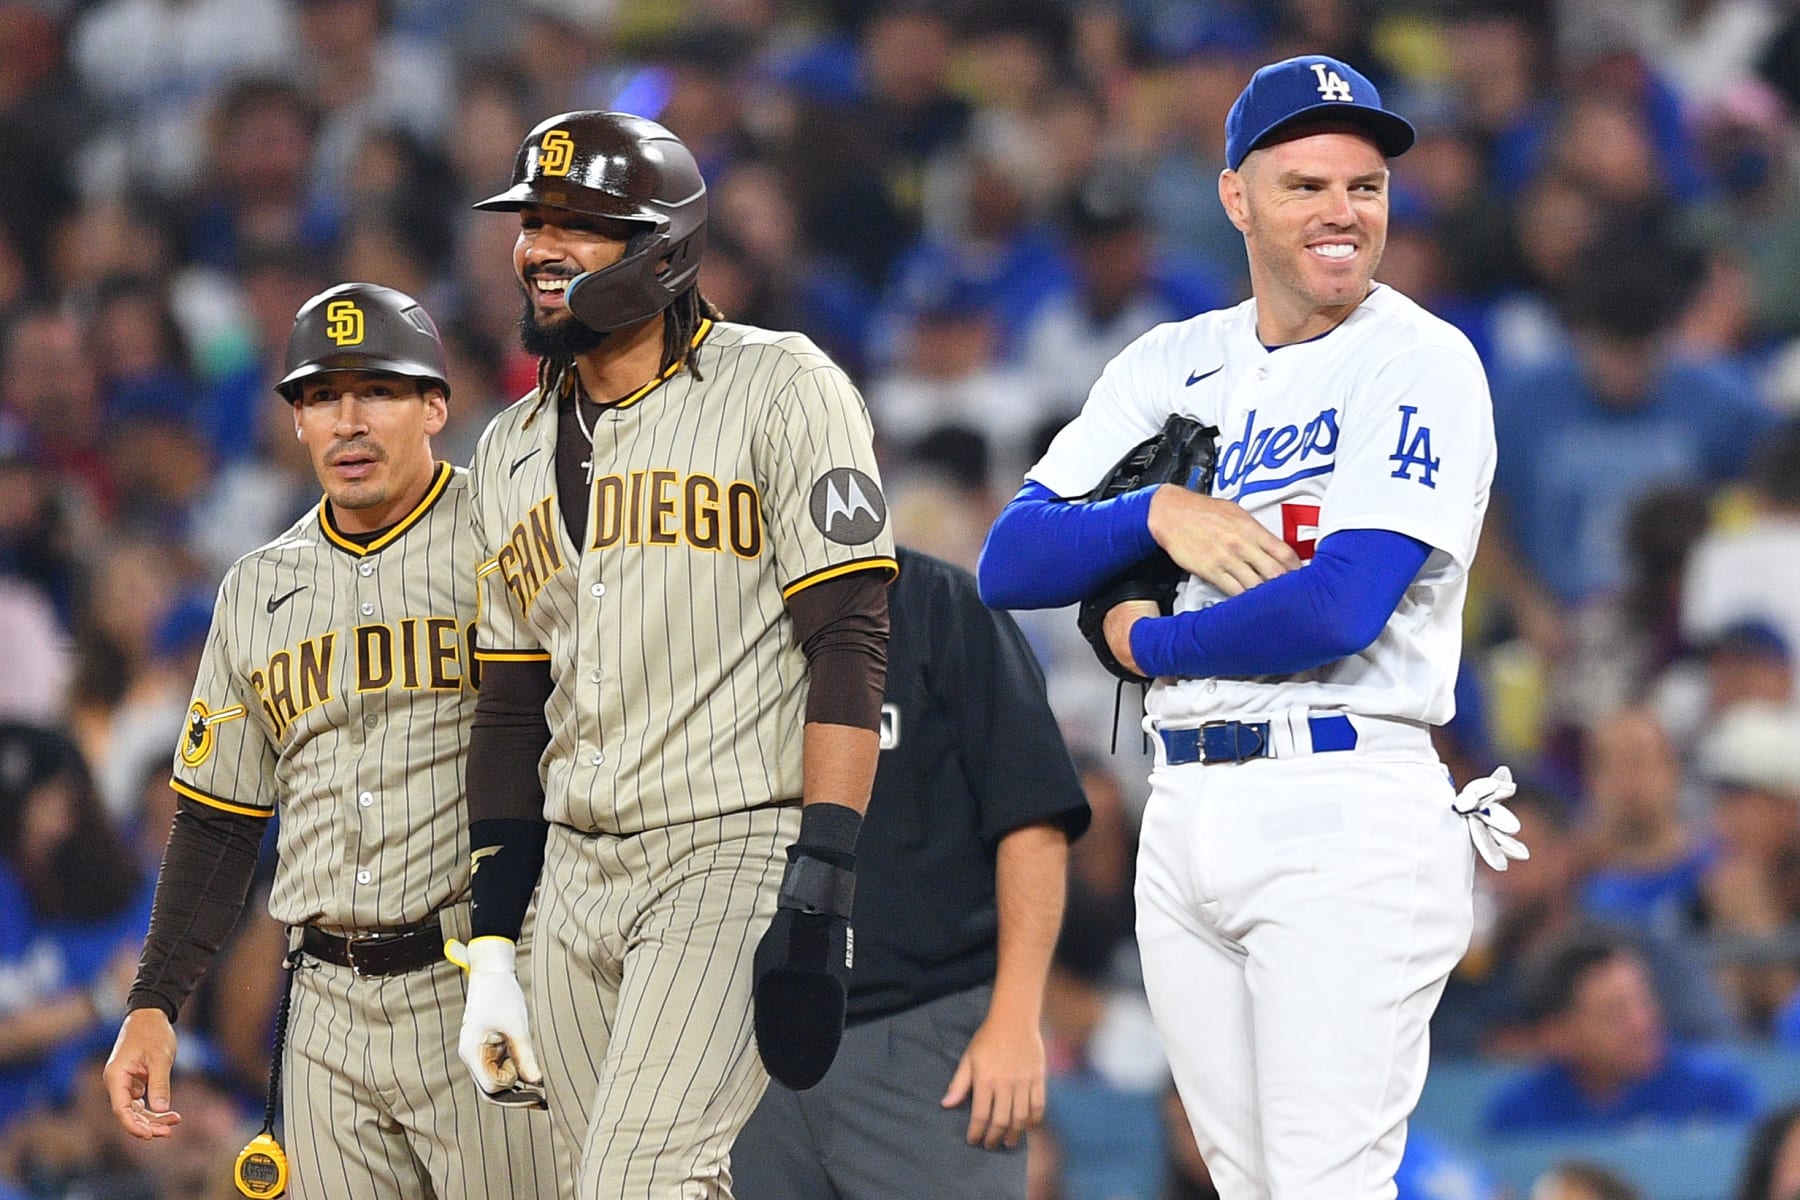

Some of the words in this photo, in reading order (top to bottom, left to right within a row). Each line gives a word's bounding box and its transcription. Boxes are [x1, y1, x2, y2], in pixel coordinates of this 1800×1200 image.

[1310, 64, 1354, 102] LA
[538, 129, 575, 177] SD
[326, 300, 364, 346] SD
[1216, 407, 1339, 504] dgers
[1389, 405, 1440, 489] LA
[498, 495, 564, 622] SAN
[589, 468, 763, 561] DIEGO
[354, 617, 478, 694] DIE
